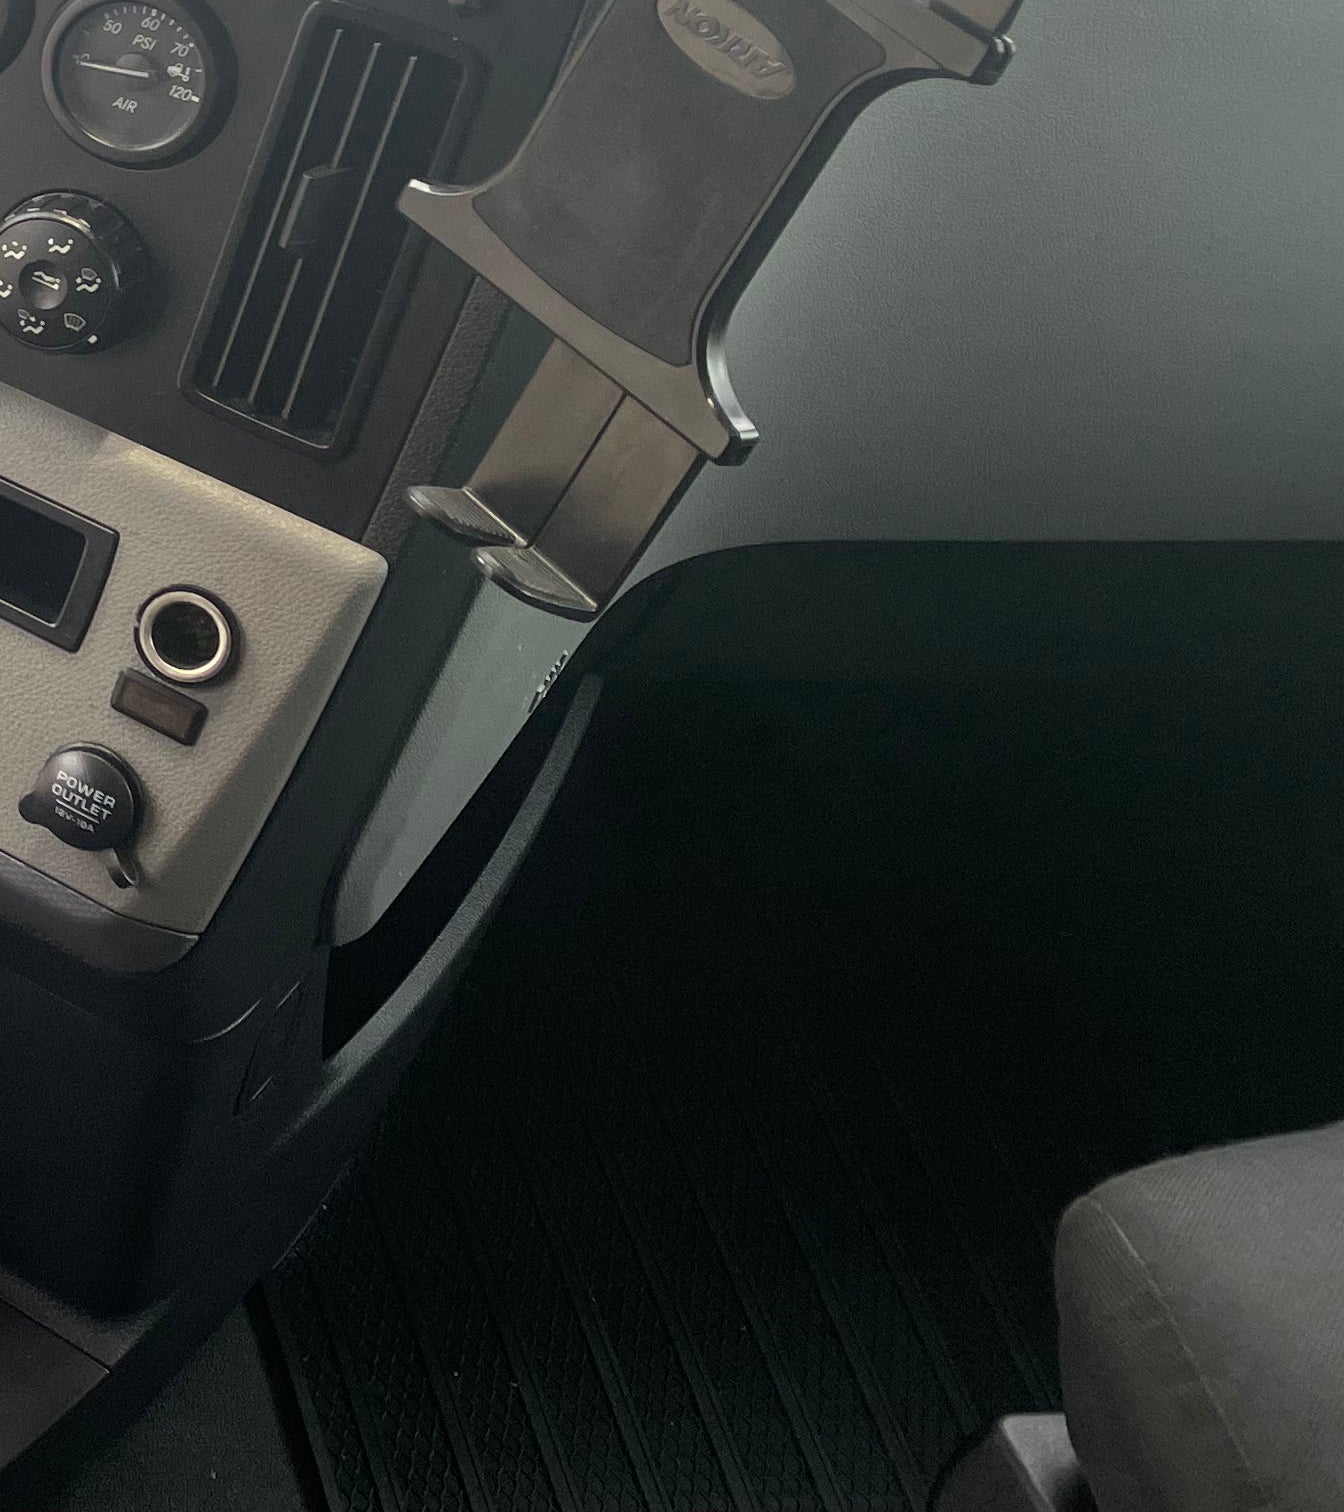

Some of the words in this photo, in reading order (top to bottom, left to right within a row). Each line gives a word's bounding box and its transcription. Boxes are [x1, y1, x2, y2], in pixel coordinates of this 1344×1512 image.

[102, 19, 123, 35] 50
[141, 16, 160, 31] 60
[132, 34, 157, 51] PSI
[170, 42, 189, 57] 70
[169, 85, 192, 101] 120
[112, 97, 138, 113] AIR
[56, 770, 116, 808] POWER
[52, 783, 112, 820] OUTLET
